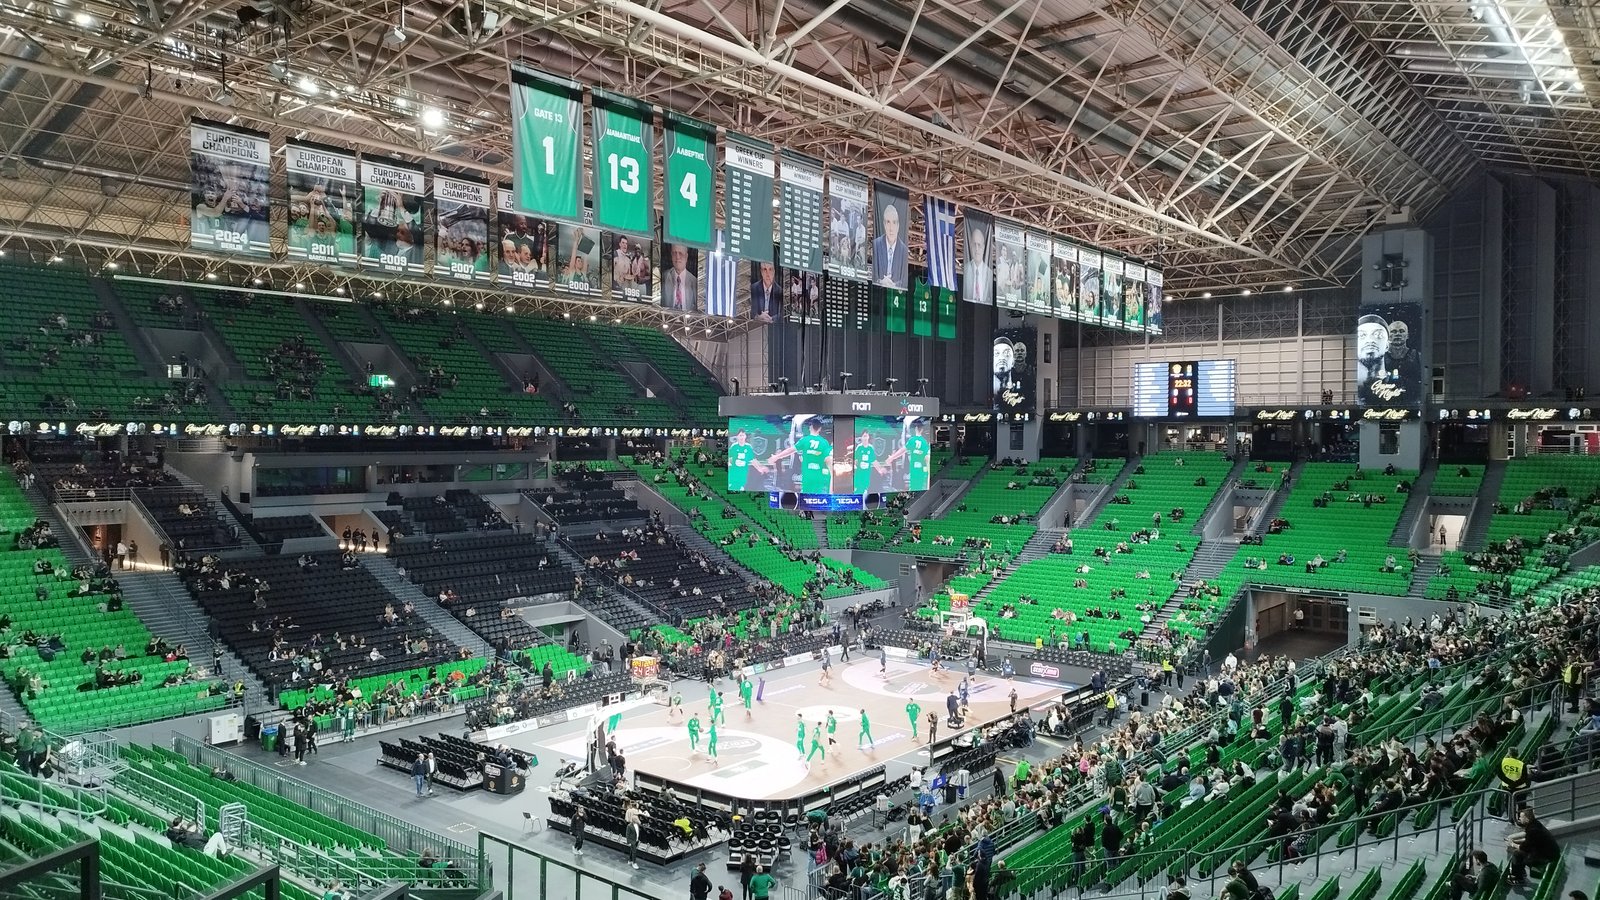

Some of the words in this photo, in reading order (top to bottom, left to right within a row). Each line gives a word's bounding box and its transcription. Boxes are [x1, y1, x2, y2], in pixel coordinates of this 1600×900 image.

[534, 108, 553, 120] GATE
[554, 113, 563, 123] 13
[206, 132, 255, 150] EUROPEAN
[203, 141, 258, 160] CHAMPIONS
[542, 136, 554, 175] 1
[736, 146, 753, 157] GREEK
[754, 151, 765, 160] CUP
[300, 152, 343, 167] EUROPEAN
[737, 154, 763, 169] WINNERS
[296, 160, 346, 176] CHAMPIONS
[608, 153, 640, 194] 13
[373, 168, 413, 182] EUROPEAN
[371, 176, 415, 190] CHAMPIONS
[444, 181, 480, 194] EUROPEAN
[680, 172, 698, 207] 4
[442, 189, 482, 202] CHAMPIONS
[215, 230, 248, 244] 2024
[312, 243, 334, 256] 2011
[380, 254, 407, 266] 2009
[451, 263, 474, 274] 2007
[513, 271, 535, 282] 2002
[569, 281, 589, 291] 2000
[625, 287, 640, 297] 1996
[894, 296, 899, 308] 4
[920, 300, 926, 312] 13
[946, 304, 949, 315] 1
[634, 667, 643, 675] 24
[645, 665, 655, 675] 24
